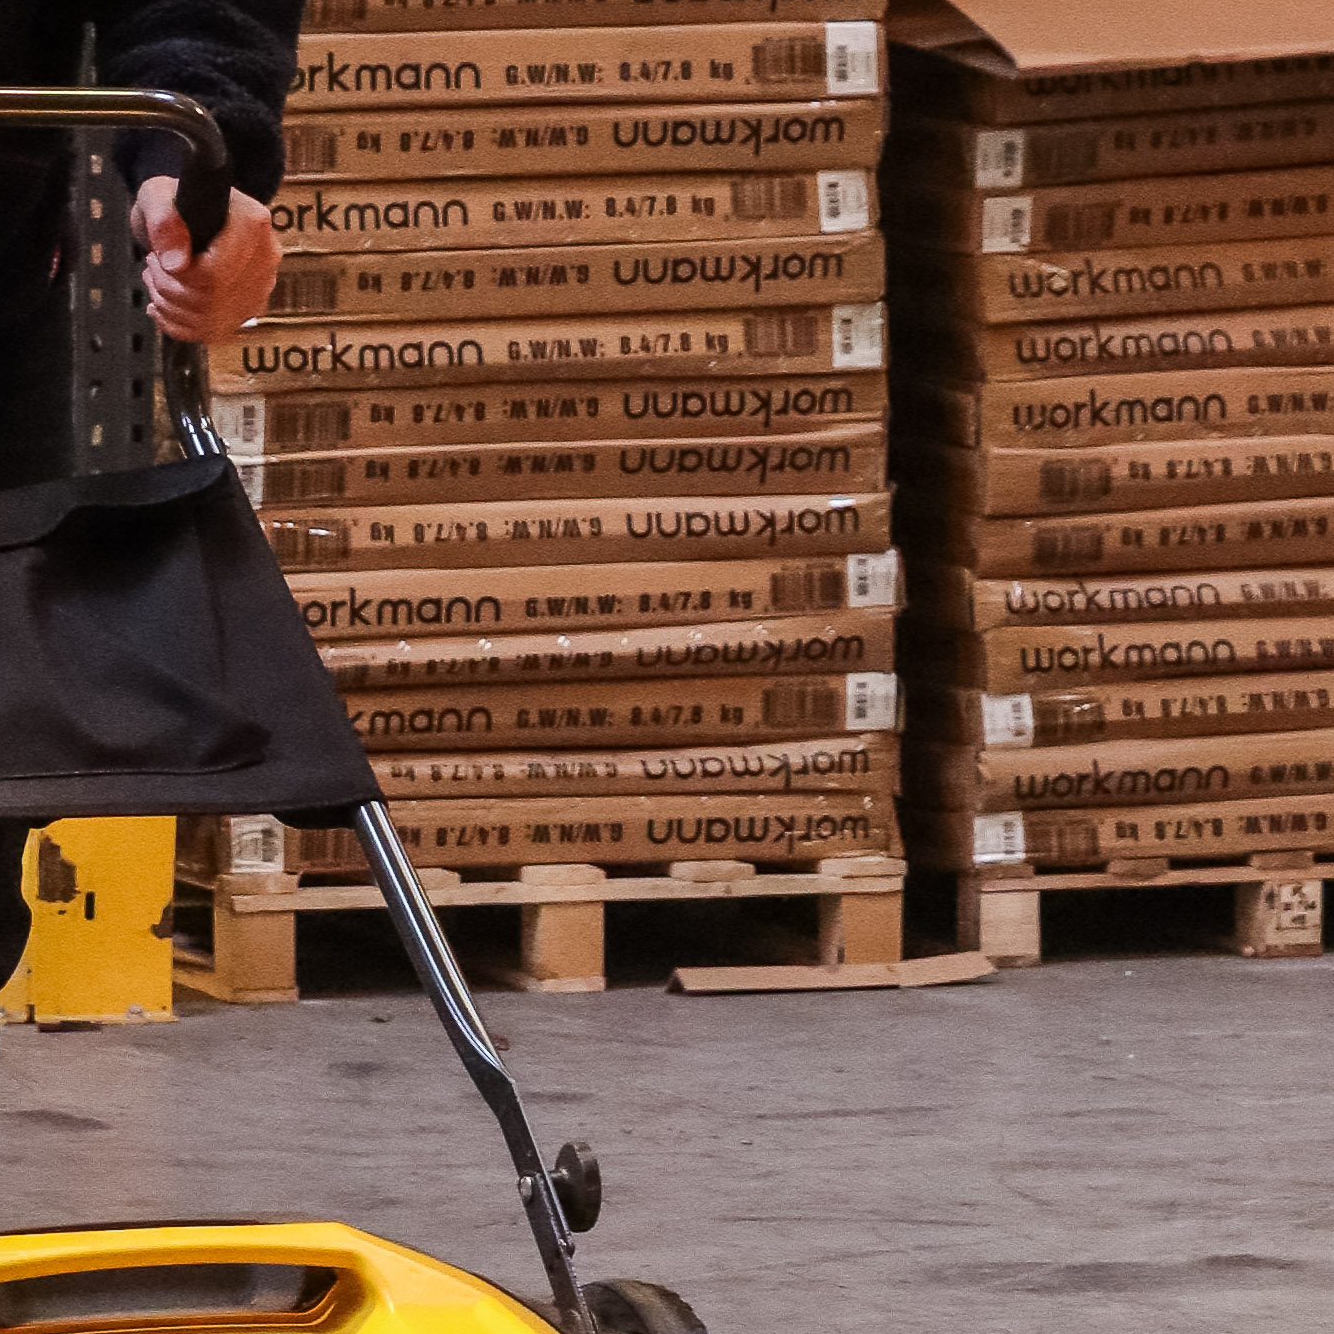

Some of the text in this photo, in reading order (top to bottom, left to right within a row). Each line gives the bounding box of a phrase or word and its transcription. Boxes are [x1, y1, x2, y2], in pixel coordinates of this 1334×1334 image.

[287, 51, 482, 94] orkmann
[709, 59, 733, 83] kg
[356, 131, 381, 154] kg
[613, 117, 845, 155] workmann
[271, 192, 469, 234] orkmann
[692, 196, 715, 219] kg
[358, 270, 382, 293] kg
[613, 253, 844, 291] workmann
[1007, 256, 1223, 298] workmann
[242, 332, 484, 376] workmann
[705, 332, 728, 356] kg
[1015, 324, 1234, 367] workmann
[370, 403, 396, 424] kg
[623, 388, 853, 428] workmann
[1013, 387, 1227, 429] workmann
[366, 457, 390, 481] kg
[619, 445, 850, 483] workmann
[370, 520, 395, 543] kg
[626, 506, 859, 546] workmann
[303, 587, 501, 629] orkmann
[728, 588, 753, 612] kg
[1005, 579, 1221, 616] workmann
[636, 634, 865, 673] workmann
[1021, 632, 1236, 674] workmann
[348, 707, 493, 737] mann
[719, 703, 743, 727] kg
[641, 748, 871, 789] workmann
[1014, 758, 1230, 802] workmann
[647, 812, 871, 853] workmann
